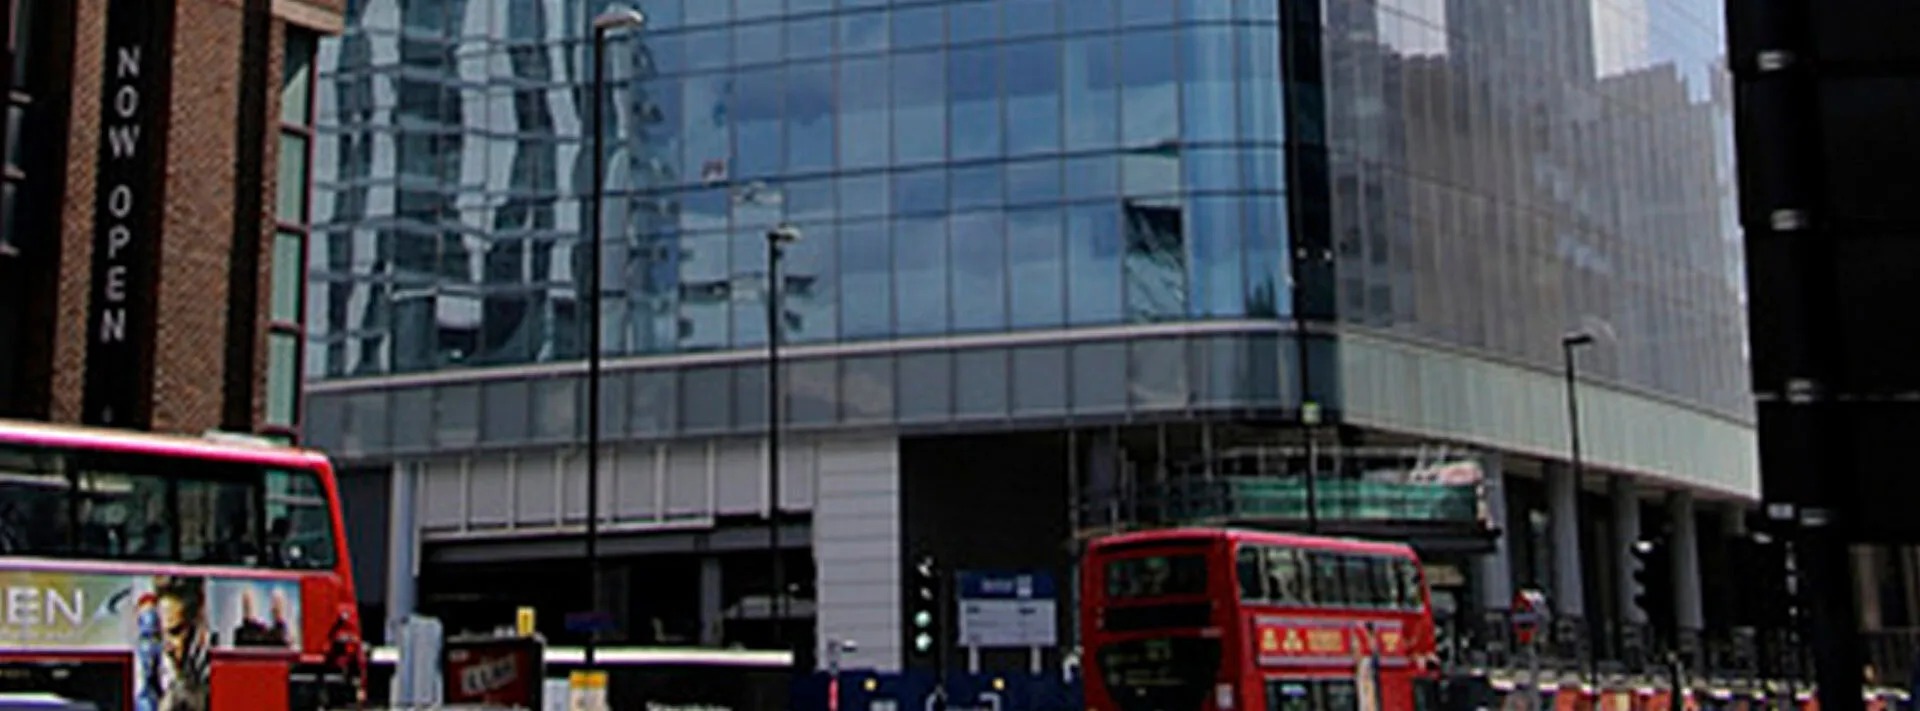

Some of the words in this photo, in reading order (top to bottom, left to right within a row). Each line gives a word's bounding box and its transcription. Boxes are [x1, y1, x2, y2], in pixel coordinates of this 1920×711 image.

[109, 45, 140, 157] NOW
[101, 184, 132, 342] OPEN
[0, 587, 84, 627] EN
